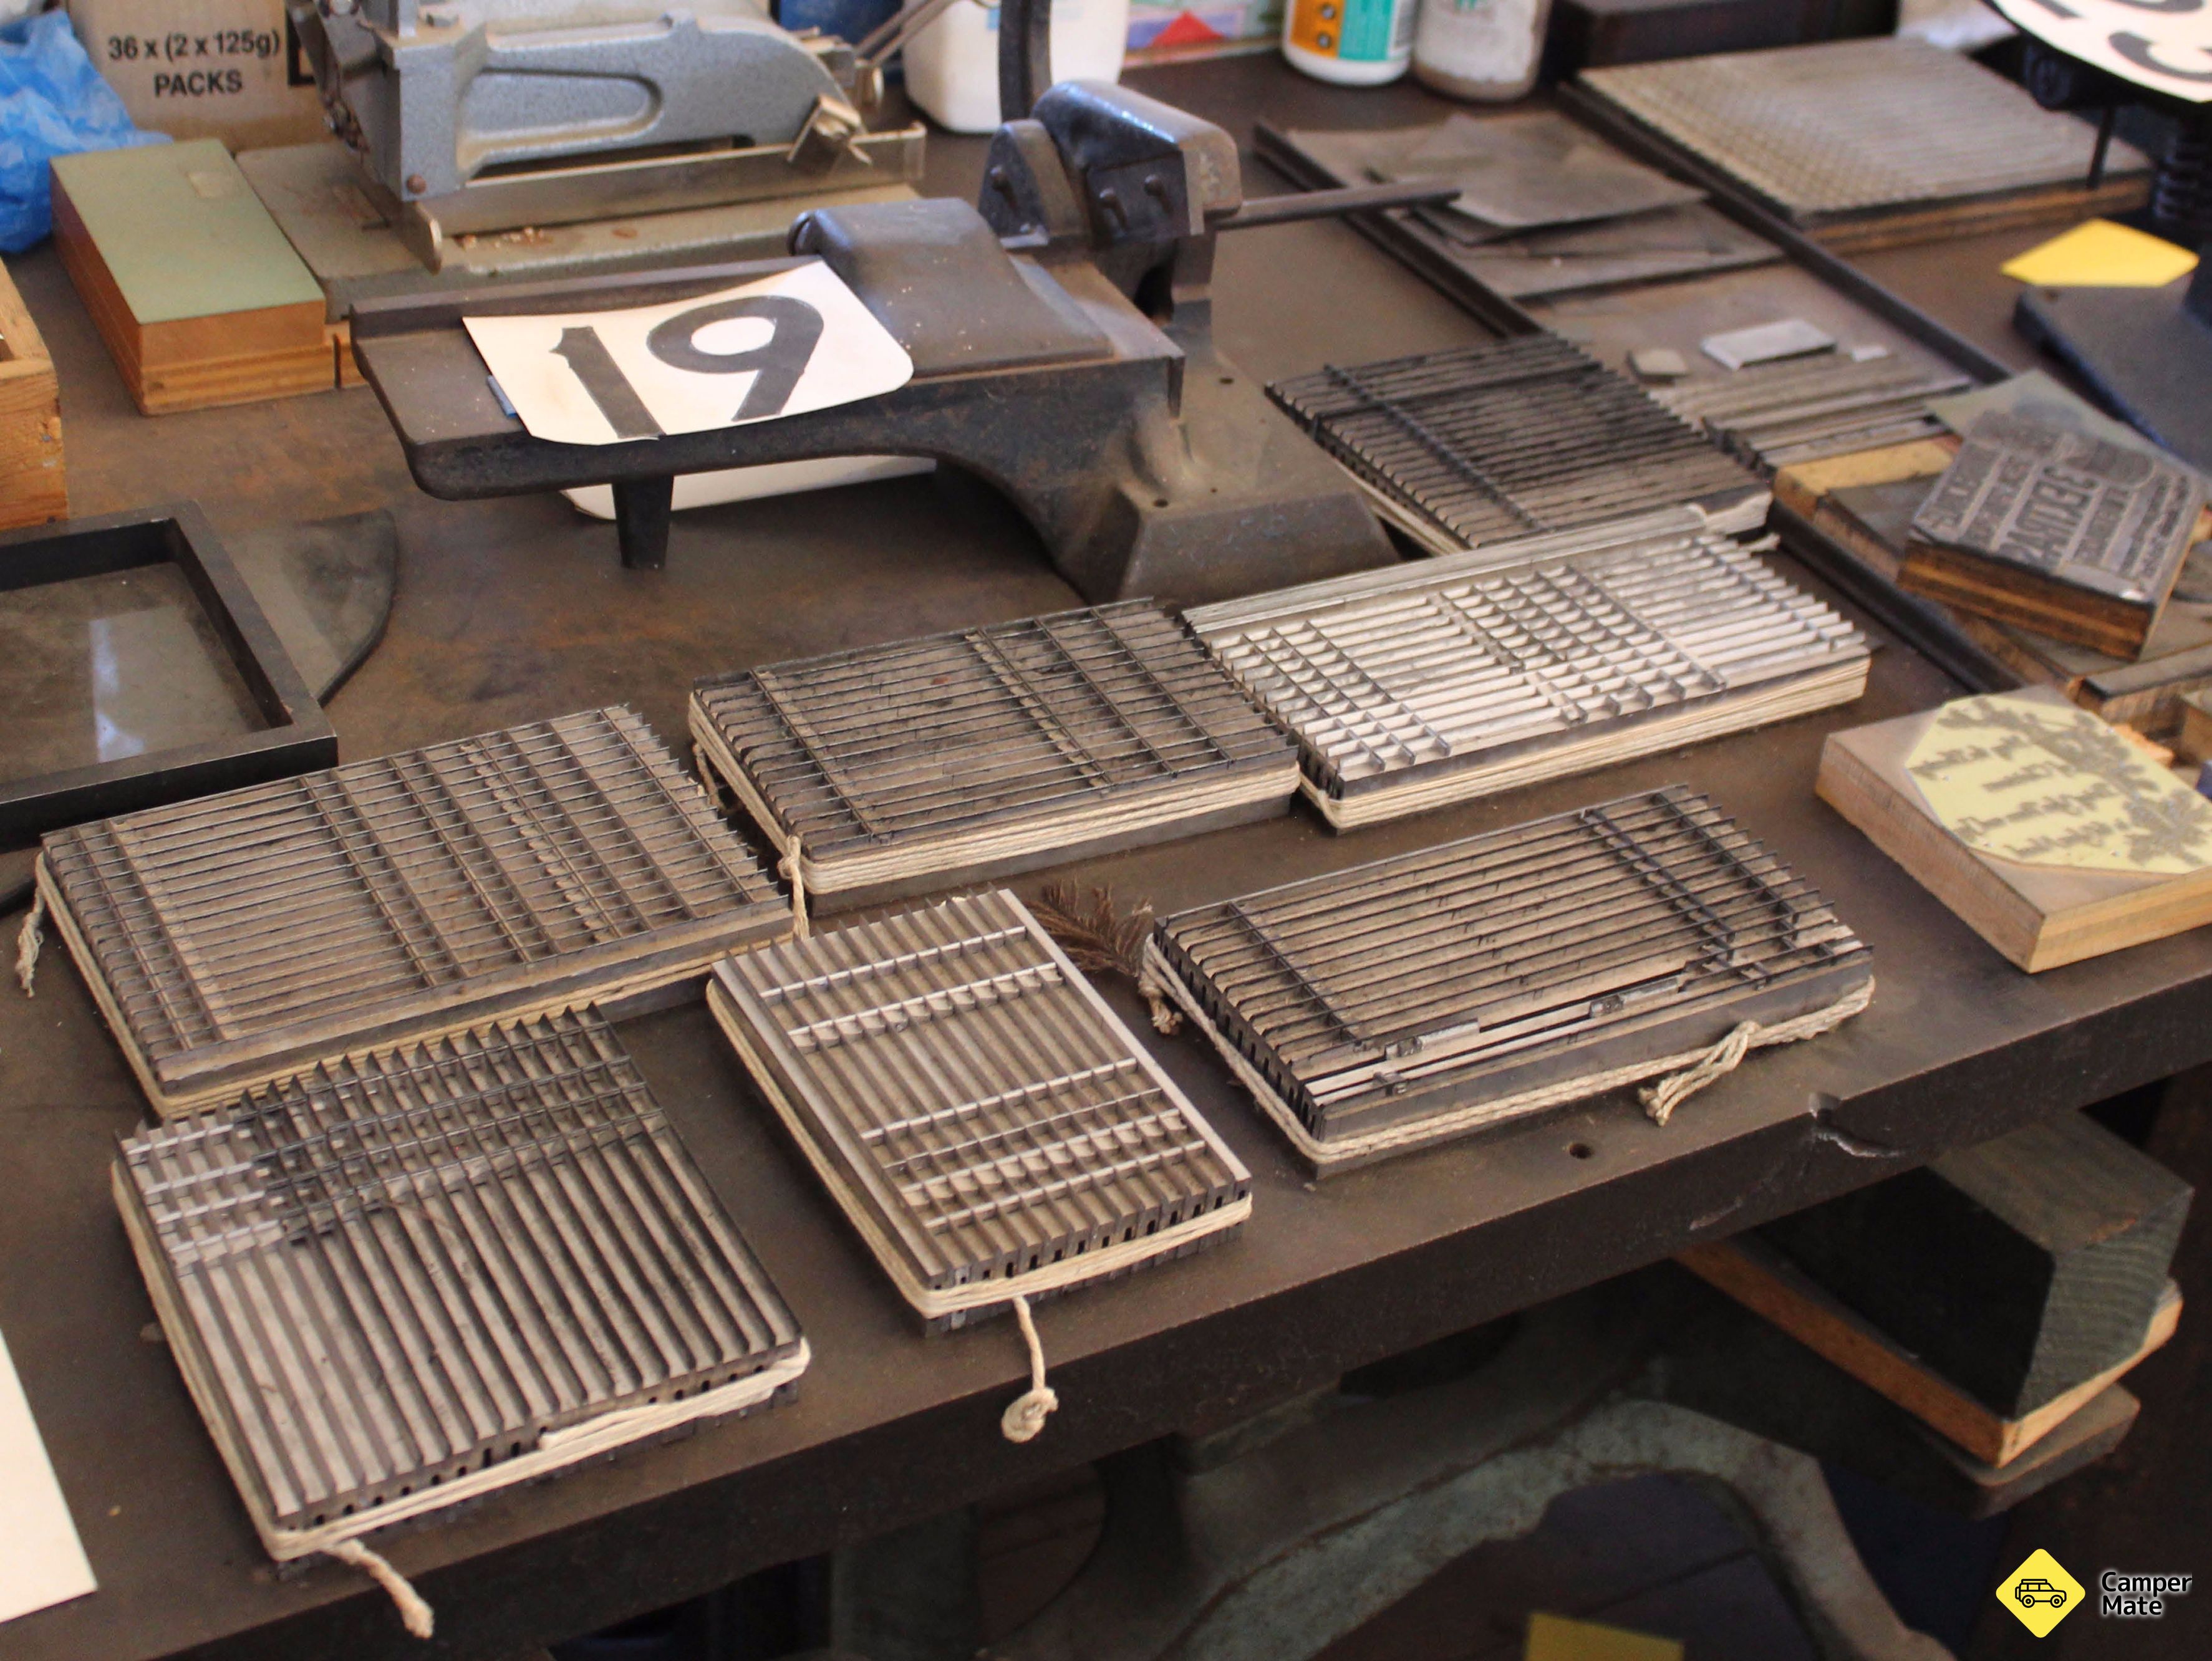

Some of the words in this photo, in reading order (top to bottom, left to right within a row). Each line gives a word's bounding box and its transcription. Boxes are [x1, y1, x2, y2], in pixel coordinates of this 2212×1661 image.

[108, 35, 138, 60] 36
[144, 39, 157, 59] x
[164, 32, 187, 63] (2
[194, 36, 208, 55] x
[214, 29, 280, 59] 125g)
[153, 69, 243, 97] PACKS
[549, 295, 824, 439] 19
